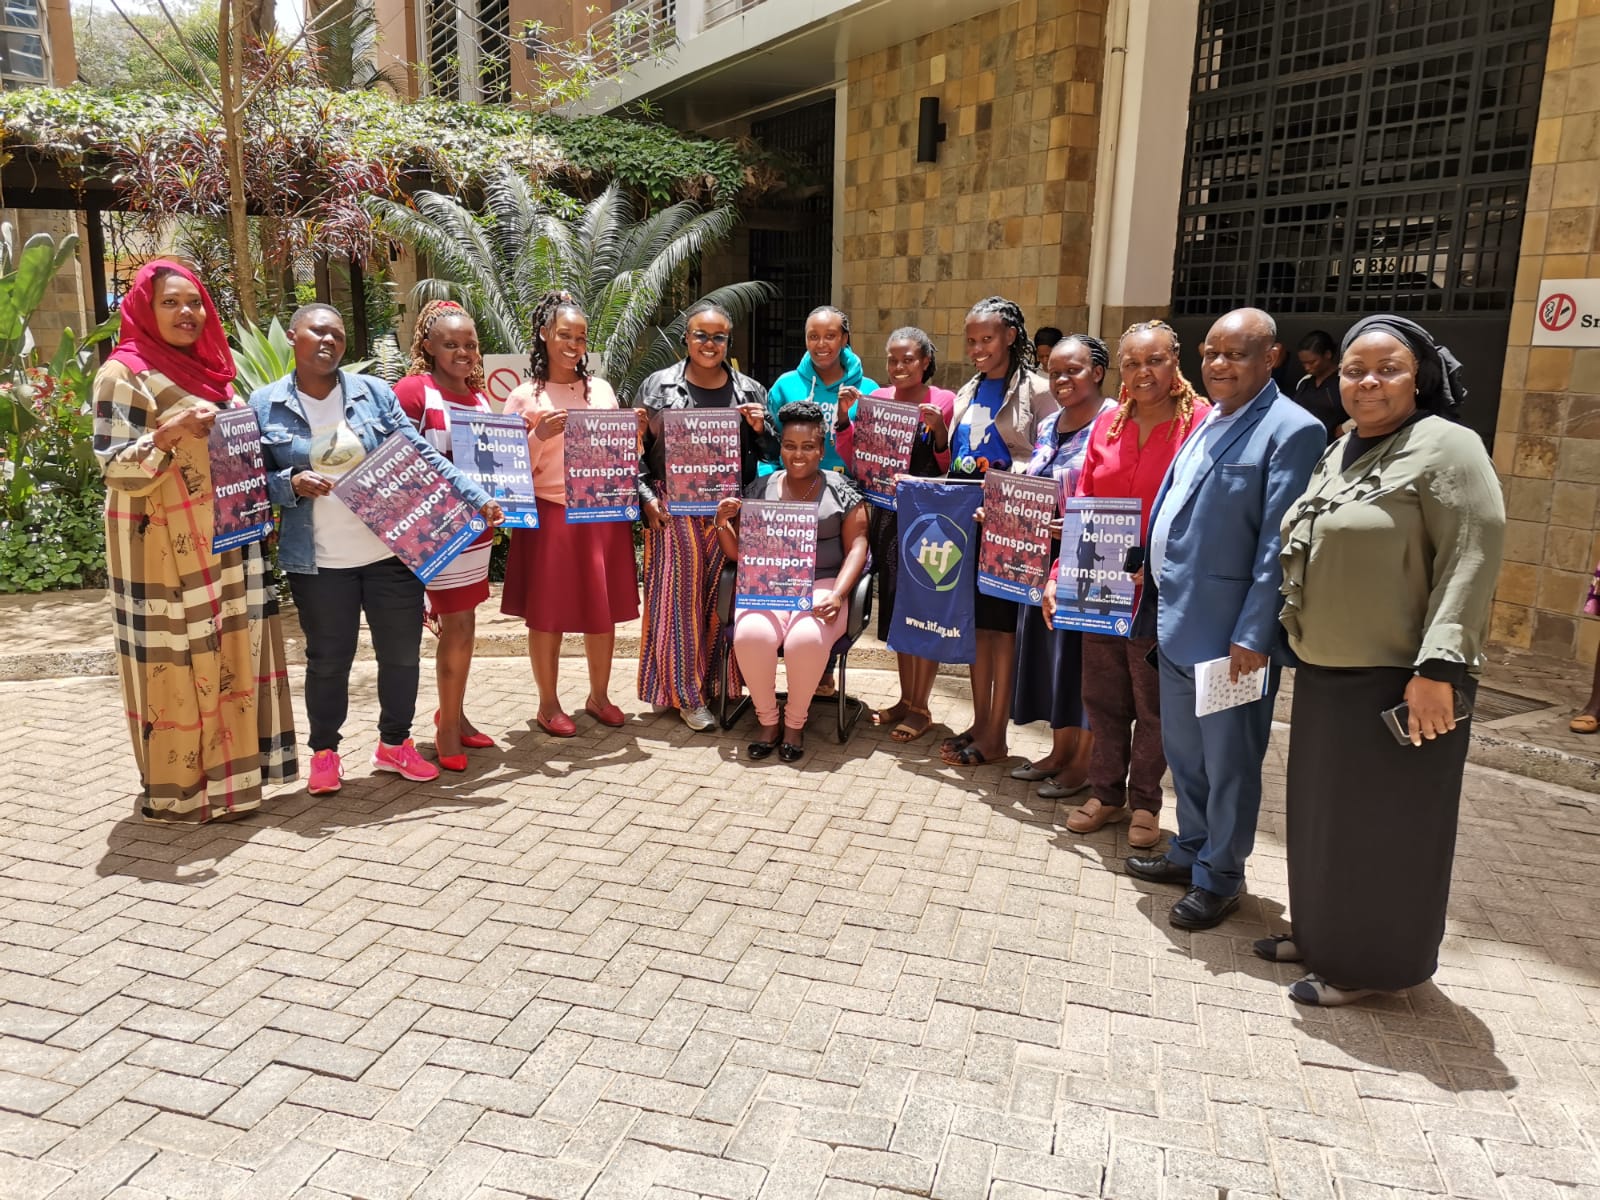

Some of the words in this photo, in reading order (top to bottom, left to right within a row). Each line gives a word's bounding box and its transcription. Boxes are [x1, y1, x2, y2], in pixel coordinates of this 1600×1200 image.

[1369, 257, 1398, 273] 836
[872, 405, 916, 425] Women
[220, 420, 257, 438] Women
[470, 422, 524, 439] Women
[585, 418, 636, 431] Women
[684, 417, 737, 430] Women
[691, 432, 738, 446] belong
[874, 422, 913, 443] belong
[228, 439, 261, 456] belong
[478, 439, 525, 457] belong
[590, 434, 636, 449] belong
[898, 442, 910, 454] in
[623, 449, 636, 461] in
[725, 446, 738, 458] in
[855, 448, 908, 469] transport
[254, 455, 263, 469] in
[357, 444, 413, 489] Women
[514, 457, 527, 469] in
[670, 461, 739, 476] transport
[377, 456, 428, 499] belong
[420, 470, 439, 486] in
[568, 465, 636, 480] transport
[215, 473, 267, 498] transport
[1000, 482, 1054, 505] Women
[385, 482, 451, 541] transport
[761, 509, 815, 523] Women
[1004, 500, 1052, 525] belong
[1080, 509, 1136, 526] Women
[766, 524, 815, 540] belong
[1035, 523, 1049, 538] in
[1082, 528, 1135, 548] belong
[800, 540, 814, 553] in
[985, 530, 1047, 555] transport
[743, 554, 813, 569] transport
[917, 537, 954, 574] itf
